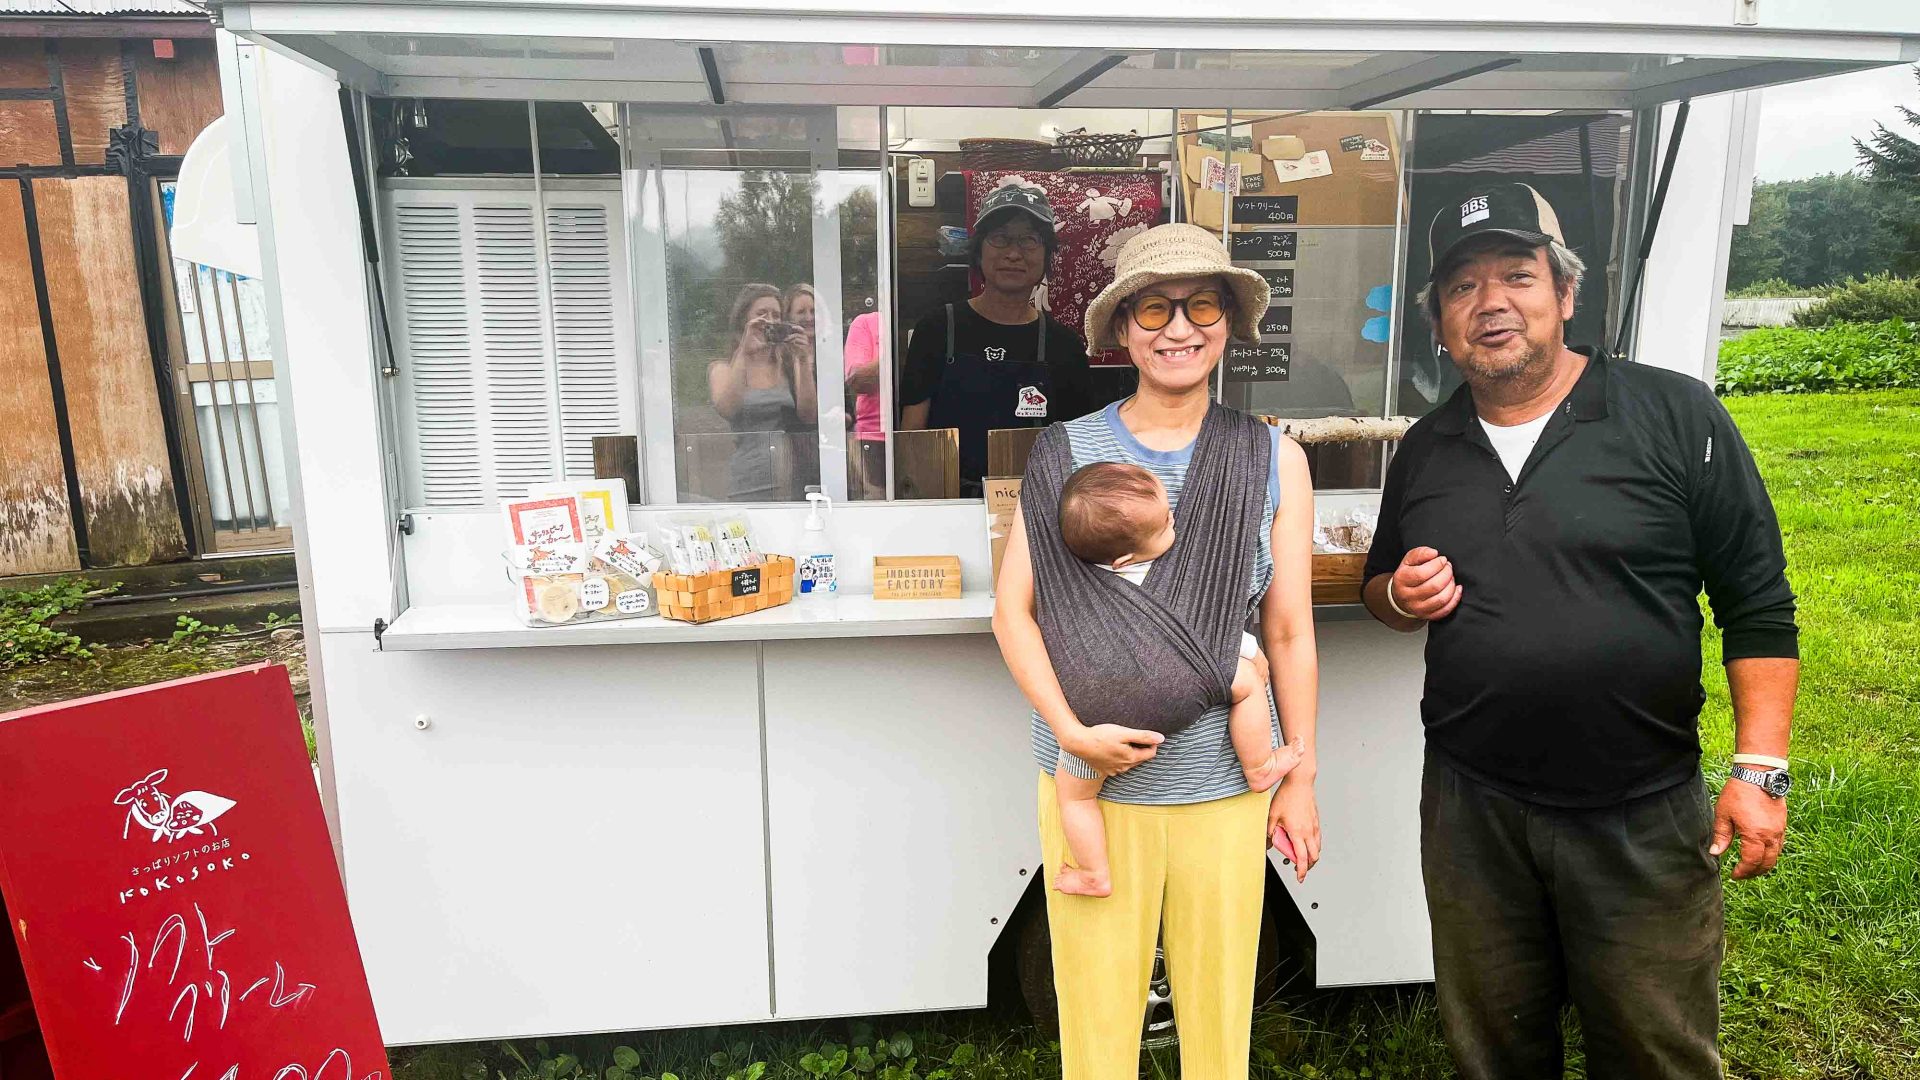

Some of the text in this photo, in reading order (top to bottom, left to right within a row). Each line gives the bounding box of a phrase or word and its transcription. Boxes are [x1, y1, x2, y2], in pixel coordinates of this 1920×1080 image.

[1237, 202, 1281, 211] ソフトクリーム
[1461, 198, 1489, 217] ABS
[1268, 211, 1294, 221] 400円
[1236, 236, 1263, 246] シェイク
[1267, 249, 1291, 258] 500円
[1270, 286, 1292, 295] 250円
[1265, 324, 1289, 333] 250円
[1230, 347, 1289, 362] ホットコーヒー 250円
[1265, 366, 1287, 375] 300円
[886, 568, 947, 579] INDUSTRIAL
[887, 579, 944, 590] FACTORY
[131, 838, 231, 876] さっぱりソフトのお店
